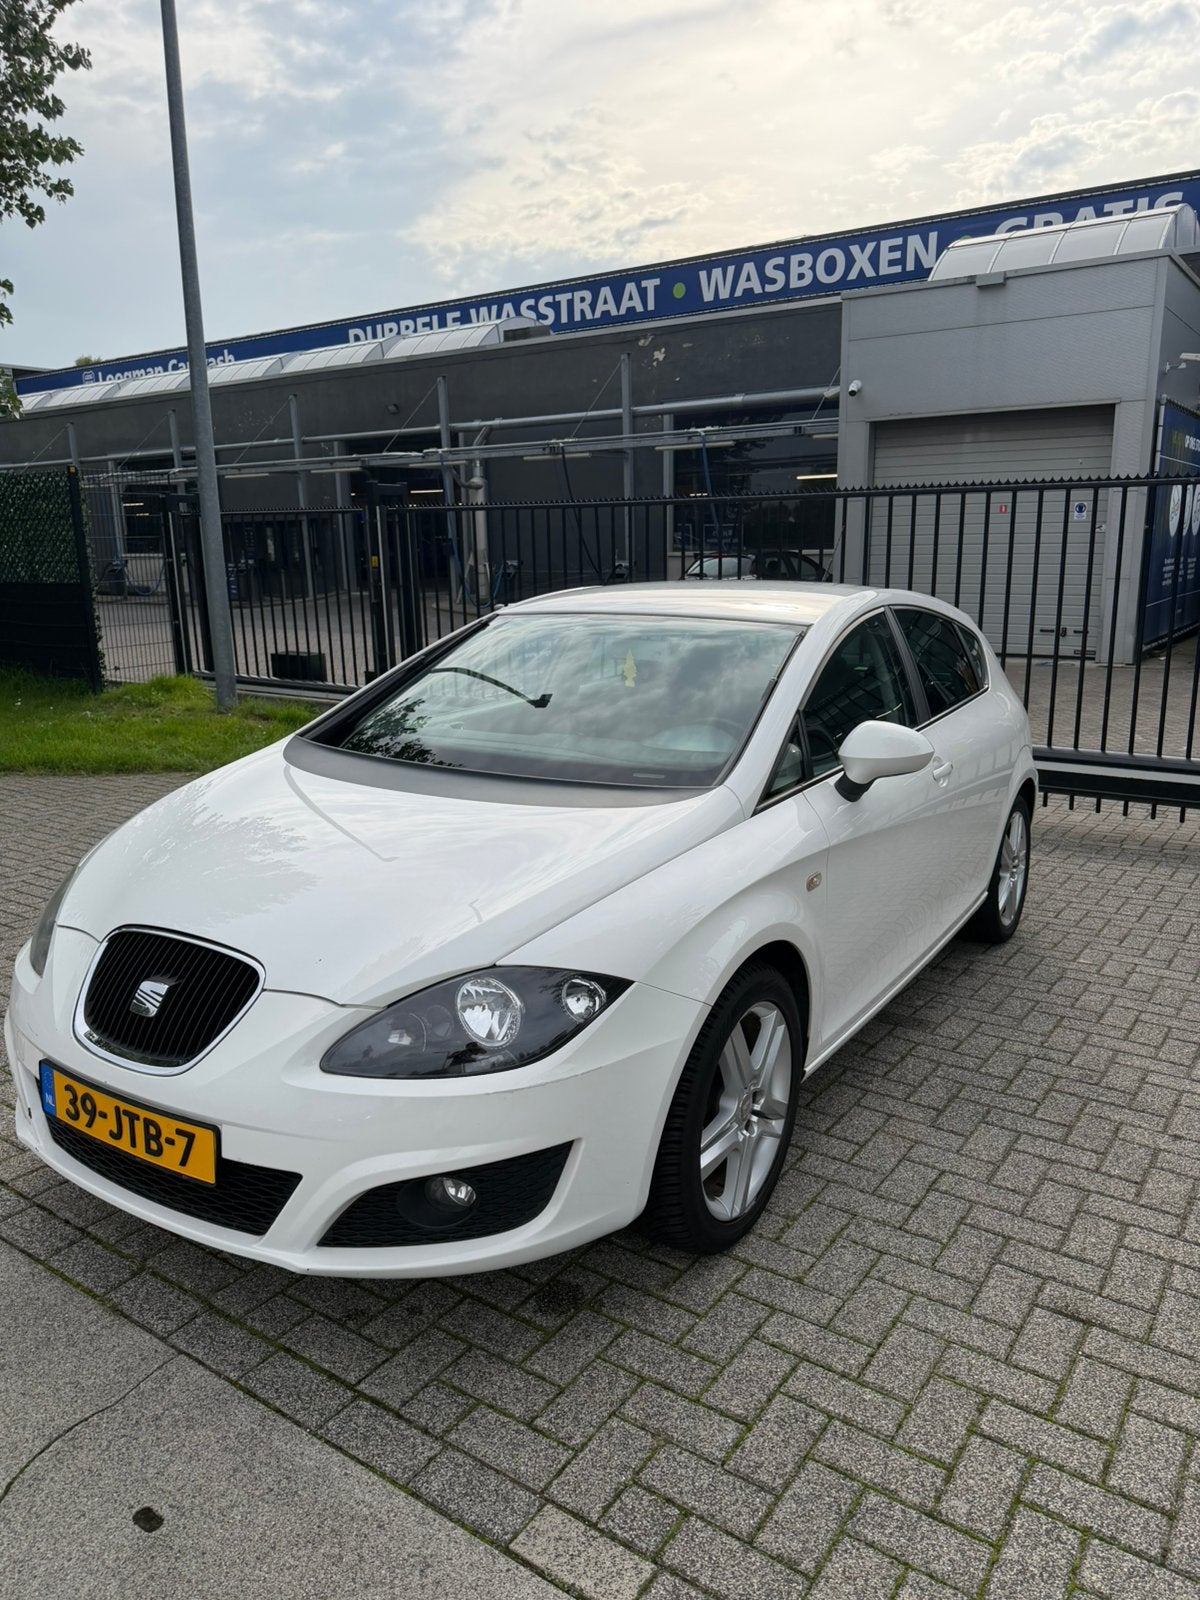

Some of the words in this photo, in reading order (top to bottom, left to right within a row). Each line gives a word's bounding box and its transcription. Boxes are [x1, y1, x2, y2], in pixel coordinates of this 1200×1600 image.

[470, 278, 661, 326] WASSTRAAT
[698, 231, 939, 302] WASBOXEN
[64, 1083, 196, 1168] 39-JTB-7
